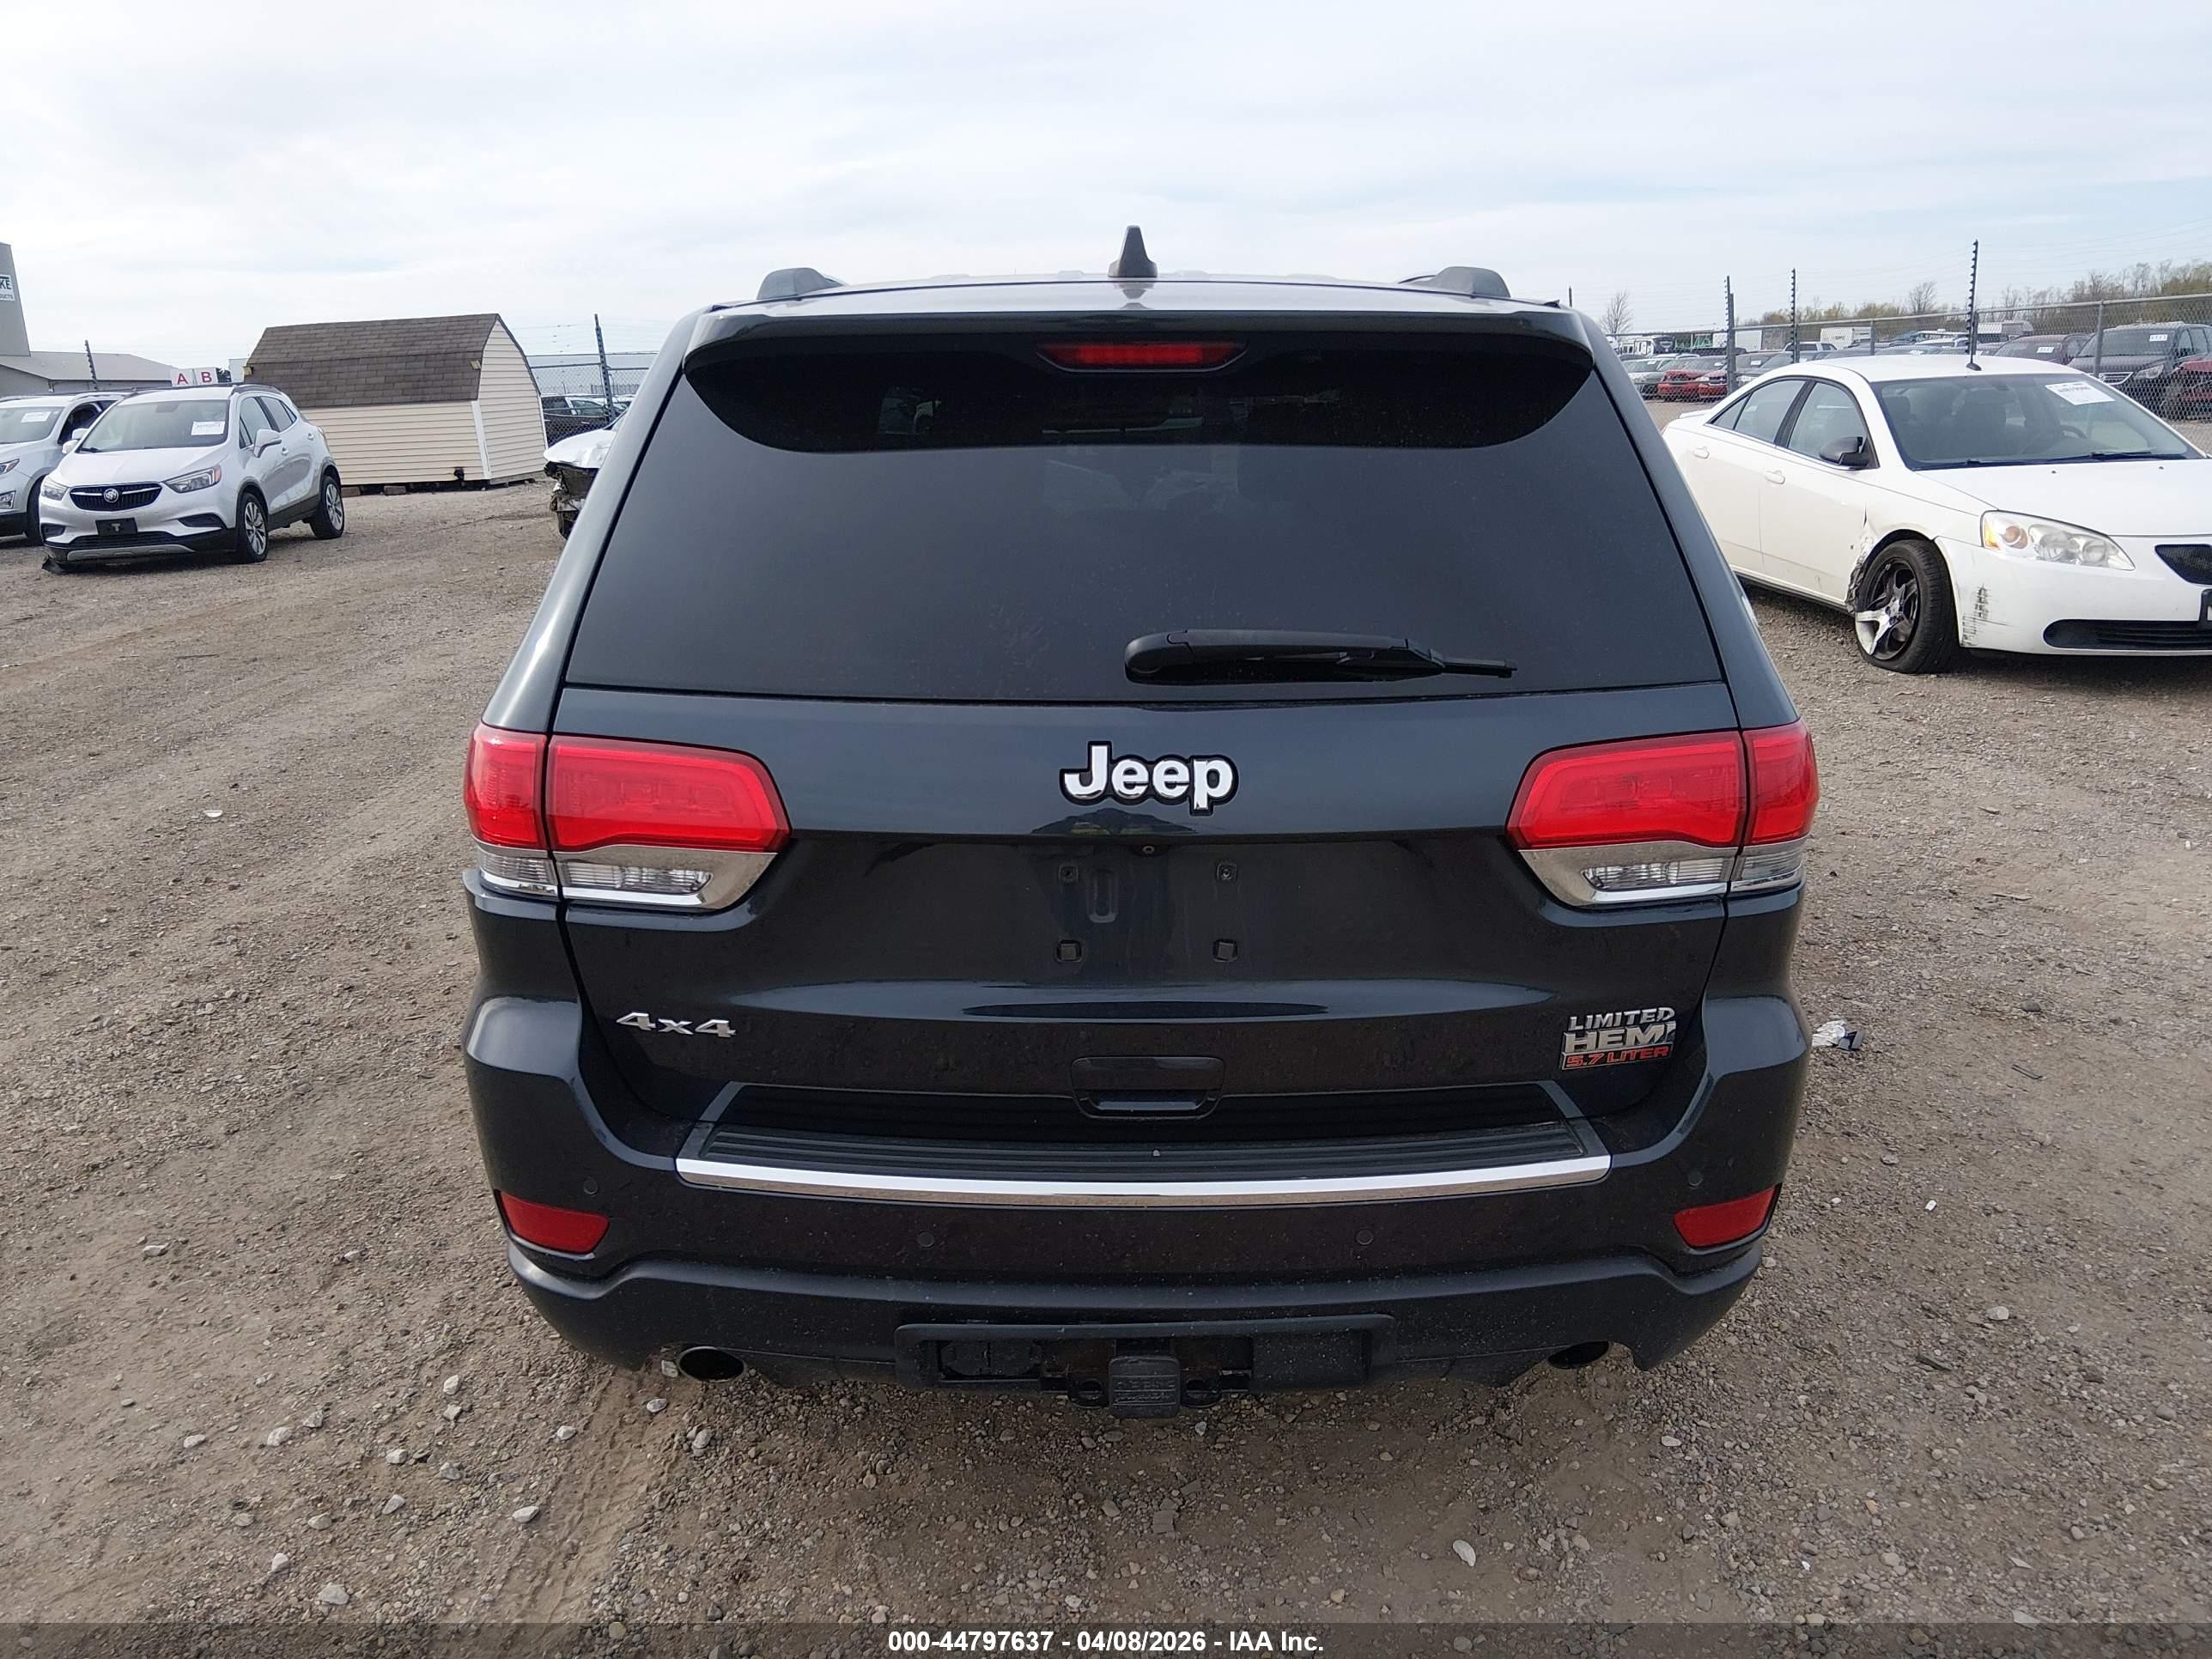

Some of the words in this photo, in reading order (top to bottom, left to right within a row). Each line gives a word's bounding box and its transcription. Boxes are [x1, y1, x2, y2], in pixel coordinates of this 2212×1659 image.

[177, 373, 188, 385] A
[201, 371, 212, 383] B
[1062, 744, 1236, 811] Jeep
[616, 1012, 736, 1037] 4x4
[1568, 1007, 1675, 1030] LIMITED
[1564, 1021, 1677, 1053] HEMI
[1566, 1053, 1605, 1067] 5.7
[1607, 1045, 1669, 1063] LITER
